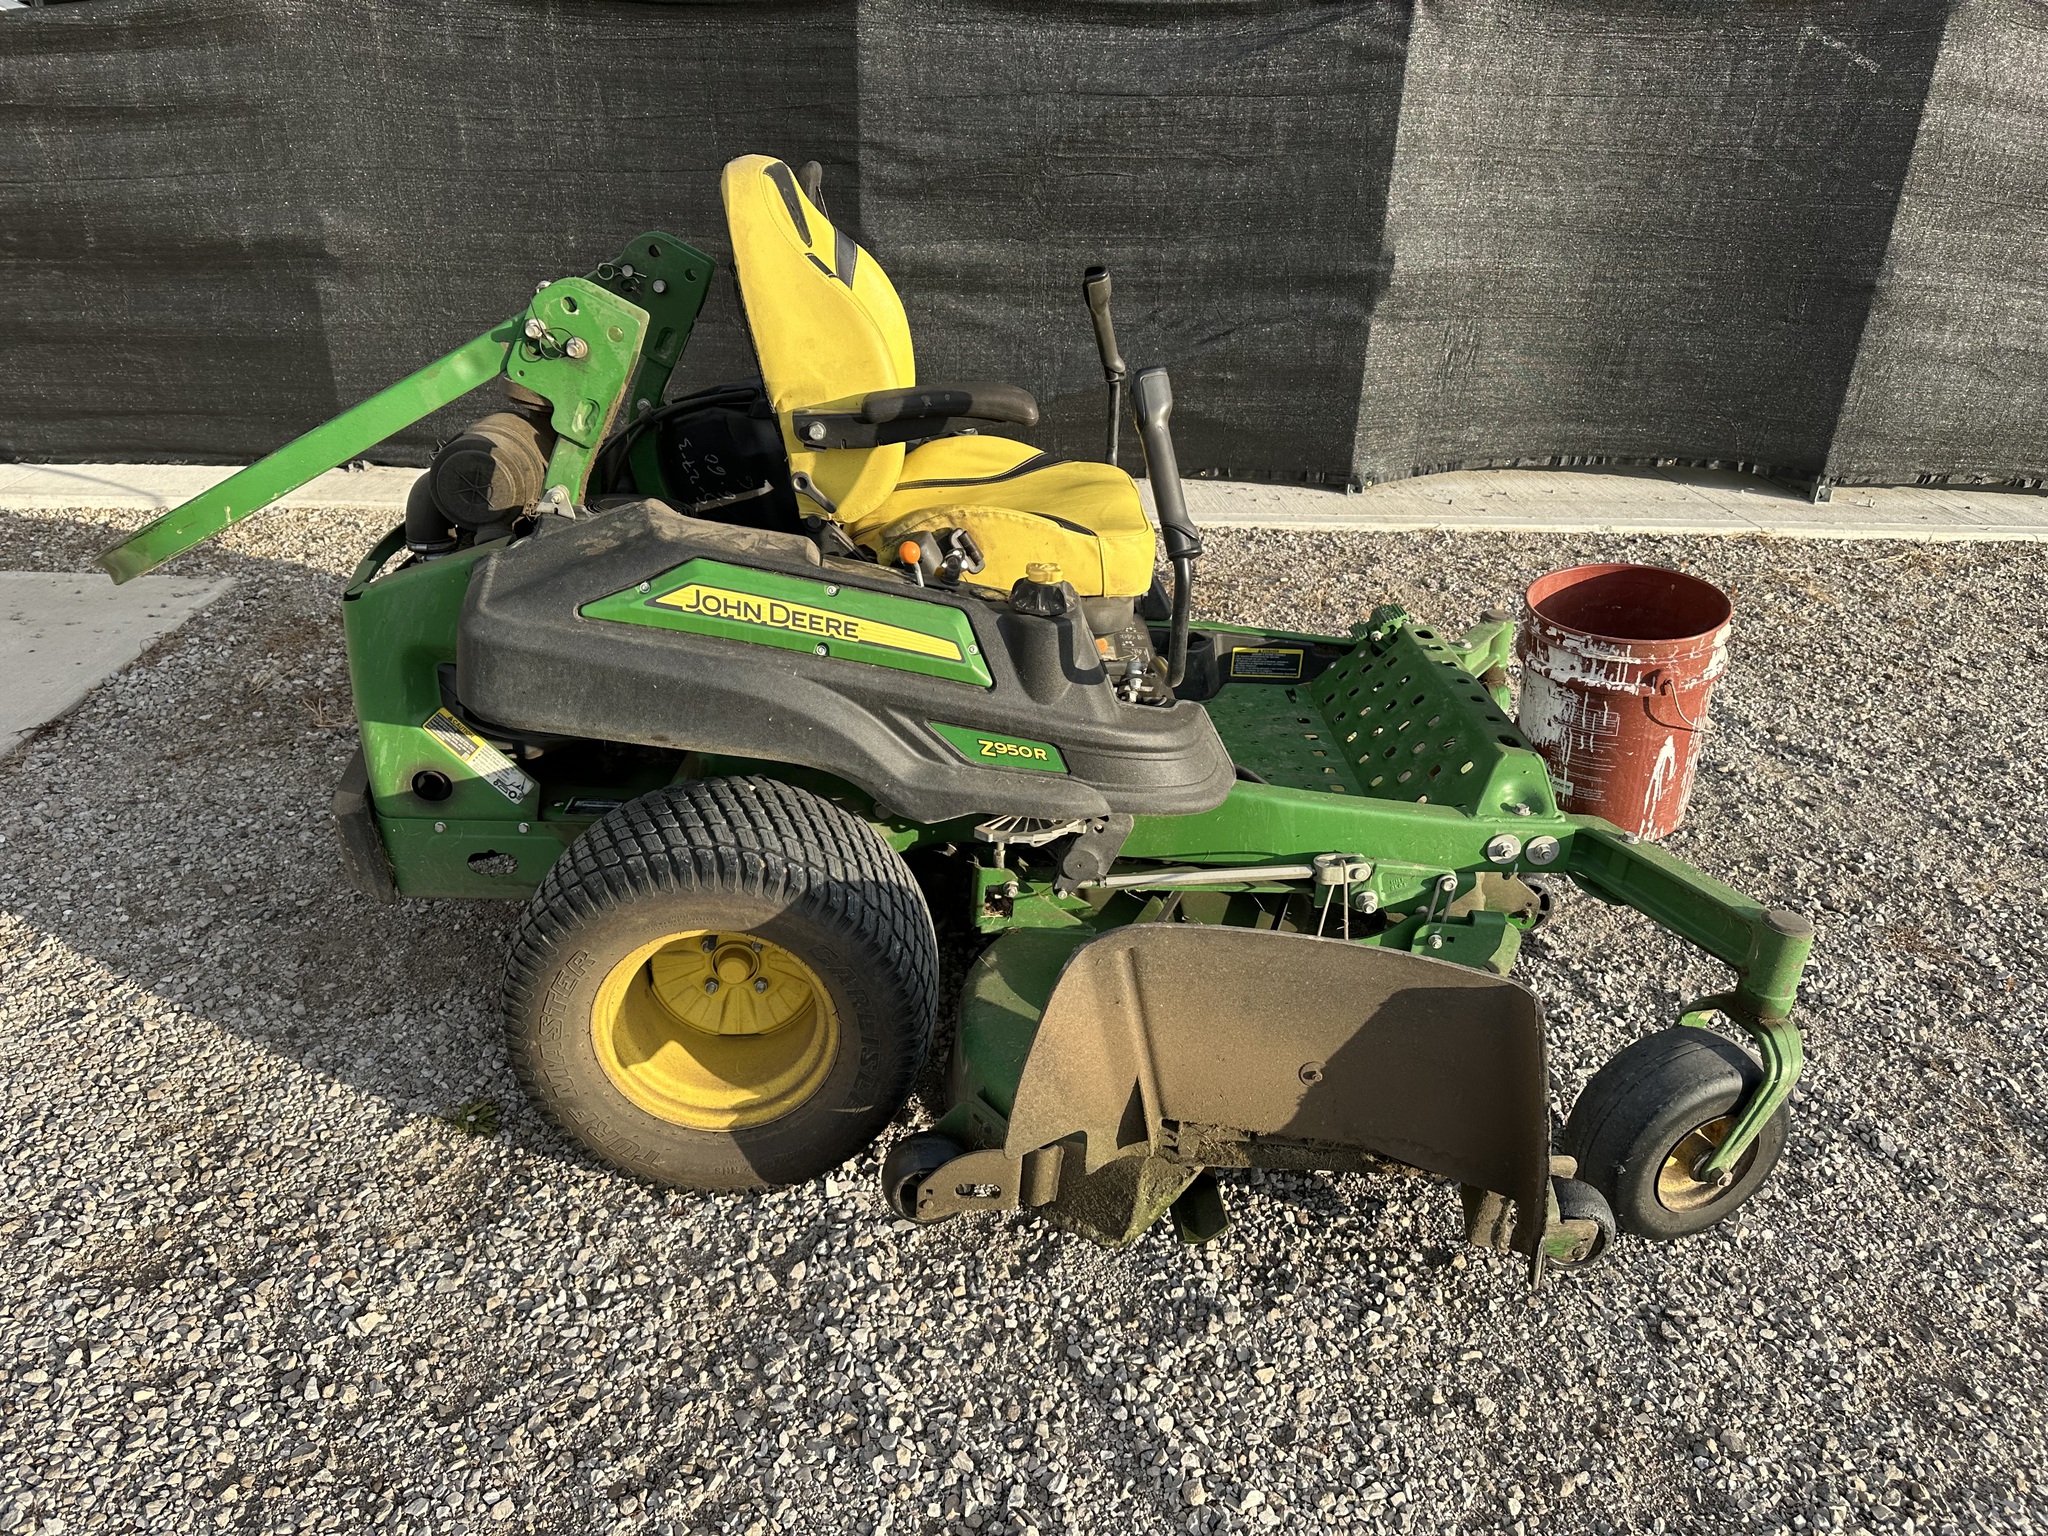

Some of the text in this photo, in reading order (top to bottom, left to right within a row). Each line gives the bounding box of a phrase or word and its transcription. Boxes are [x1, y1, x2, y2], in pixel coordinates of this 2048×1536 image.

[686, 589, 860, 640] JOHN DEERE
[452, 719, 475, 739] CAUTION
[977, 739, 1049, 761] Z950R
[812, 943, 882, 1116] CARLISLE
[538, 950, 662, 1169] TURF MASTER
